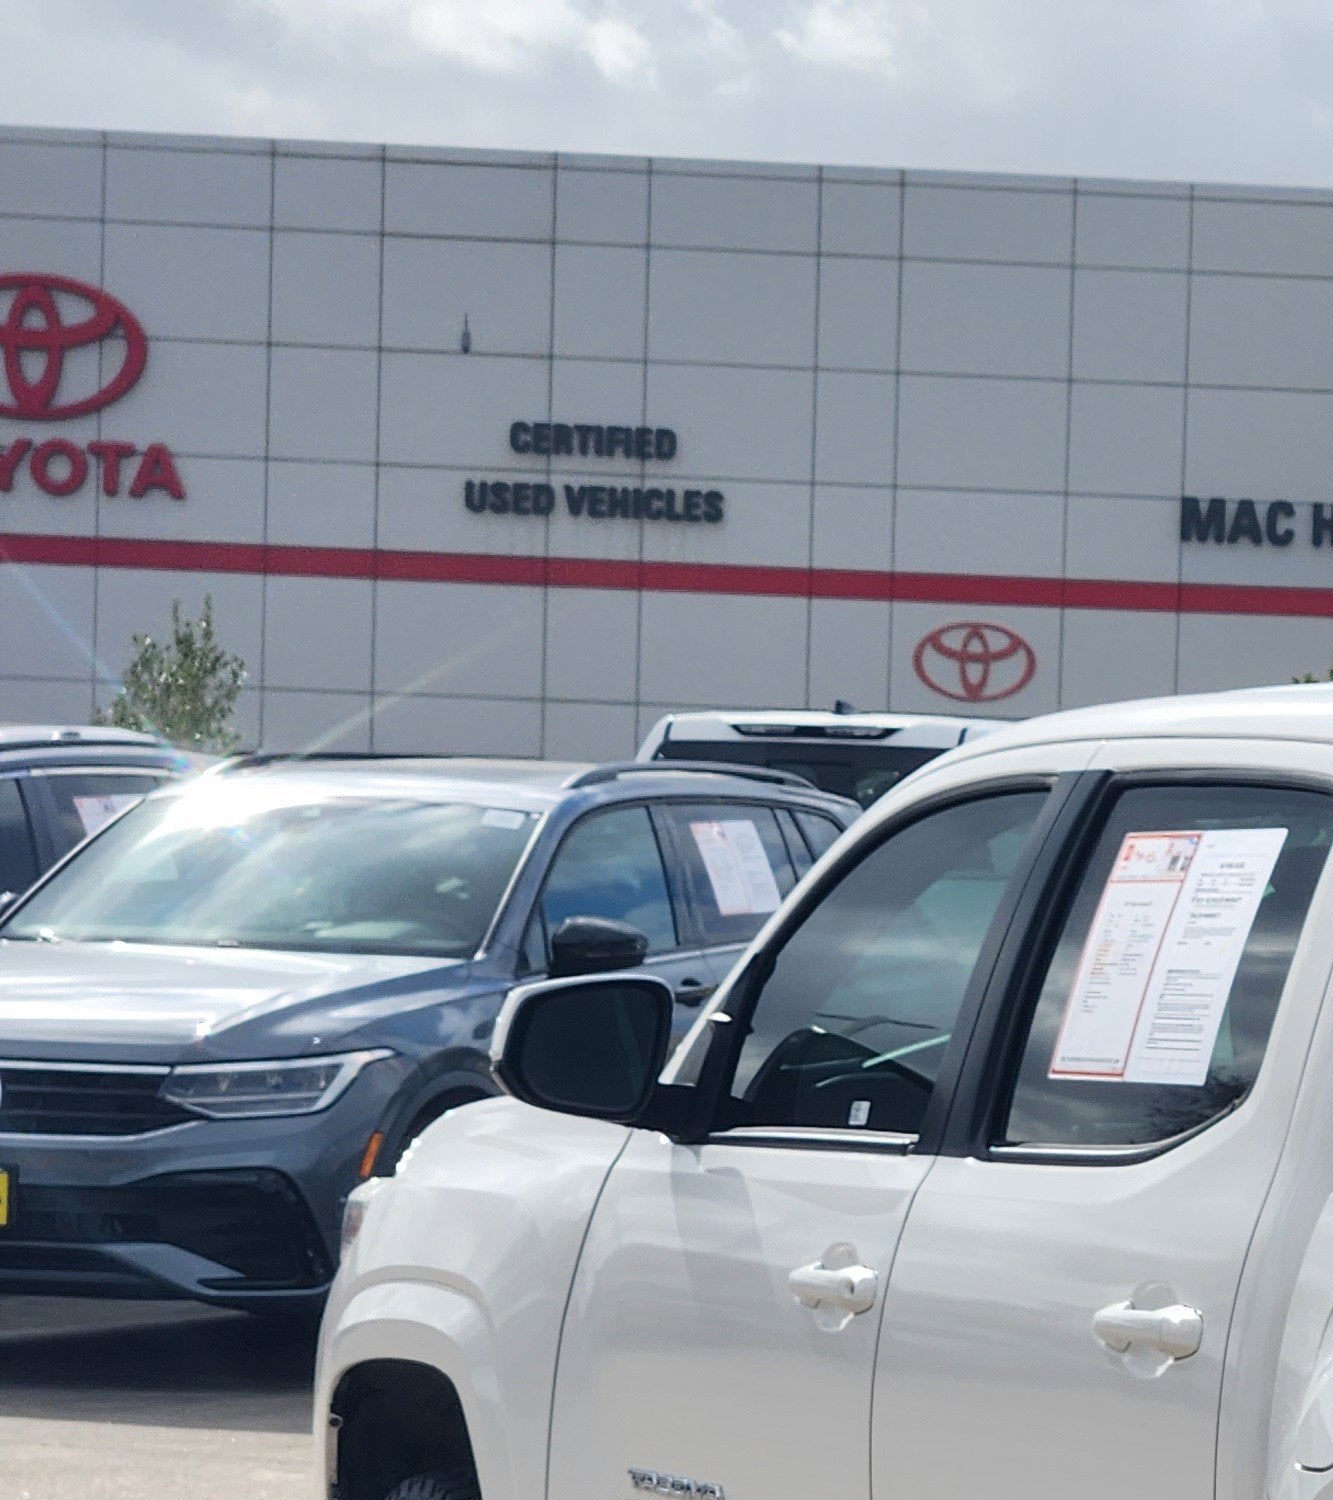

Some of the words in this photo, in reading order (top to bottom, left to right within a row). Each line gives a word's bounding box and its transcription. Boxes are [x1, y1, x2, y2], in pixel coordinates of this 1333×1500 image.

[509, 420, 678, 461] CERTIFIED
[465, 480, 556, 516] USED
[563, 483, 725, 523] VEHICLES
[1180, 496, 1296, 546] MAC
